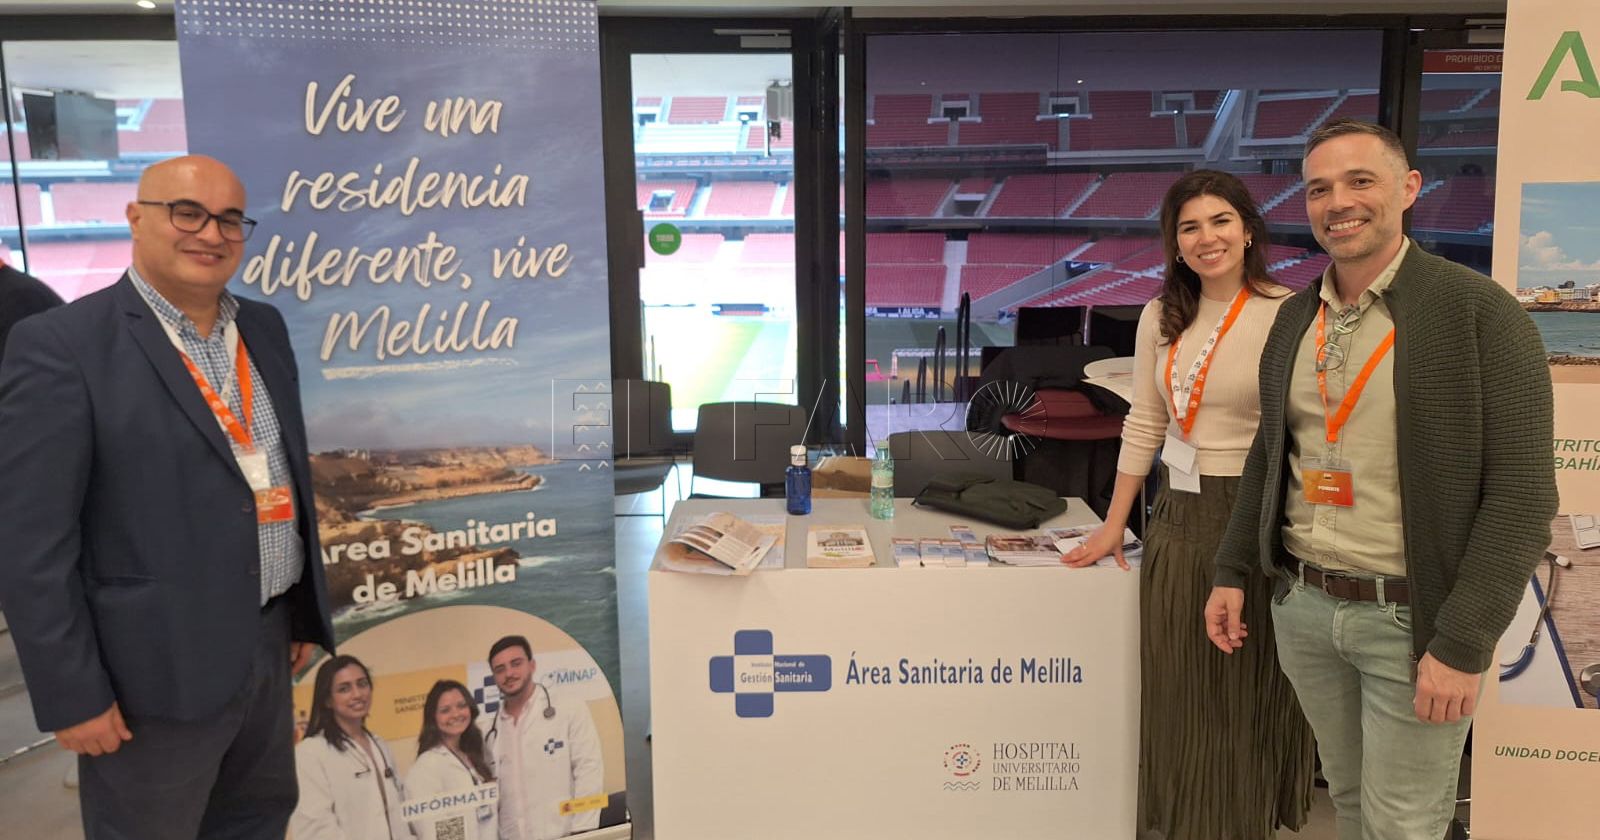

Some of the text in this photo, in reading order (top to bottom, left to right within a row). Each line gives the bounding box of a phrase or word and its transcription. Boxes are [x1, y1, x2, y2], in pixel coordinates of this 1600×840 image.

[1445, 55, 1494, 63] PROHIBIDO
[304, 73, 503, 138] Vive una
[281, 157, 530, 216] residencia
[242, 231, 573, 300] diferente, vive
[319, 300, 519, 361] Melilla
[401, 512, 557, 556] Sanitaria
[352, 556, 516, 604] de Melilla
[741, 671, 813, 684] Gestión Sanitaria
[846, 651, 1083, 684] Área Sanitaria de Melilla
[993, 742, 1080, 760] HOSPITAL
[1495, 746, 1600, 762] UNIDAD DOCE
[992, 762, 1080, 774] UNIVERSITARIO
[992, 776, 1079, 791] DE MELILLA
